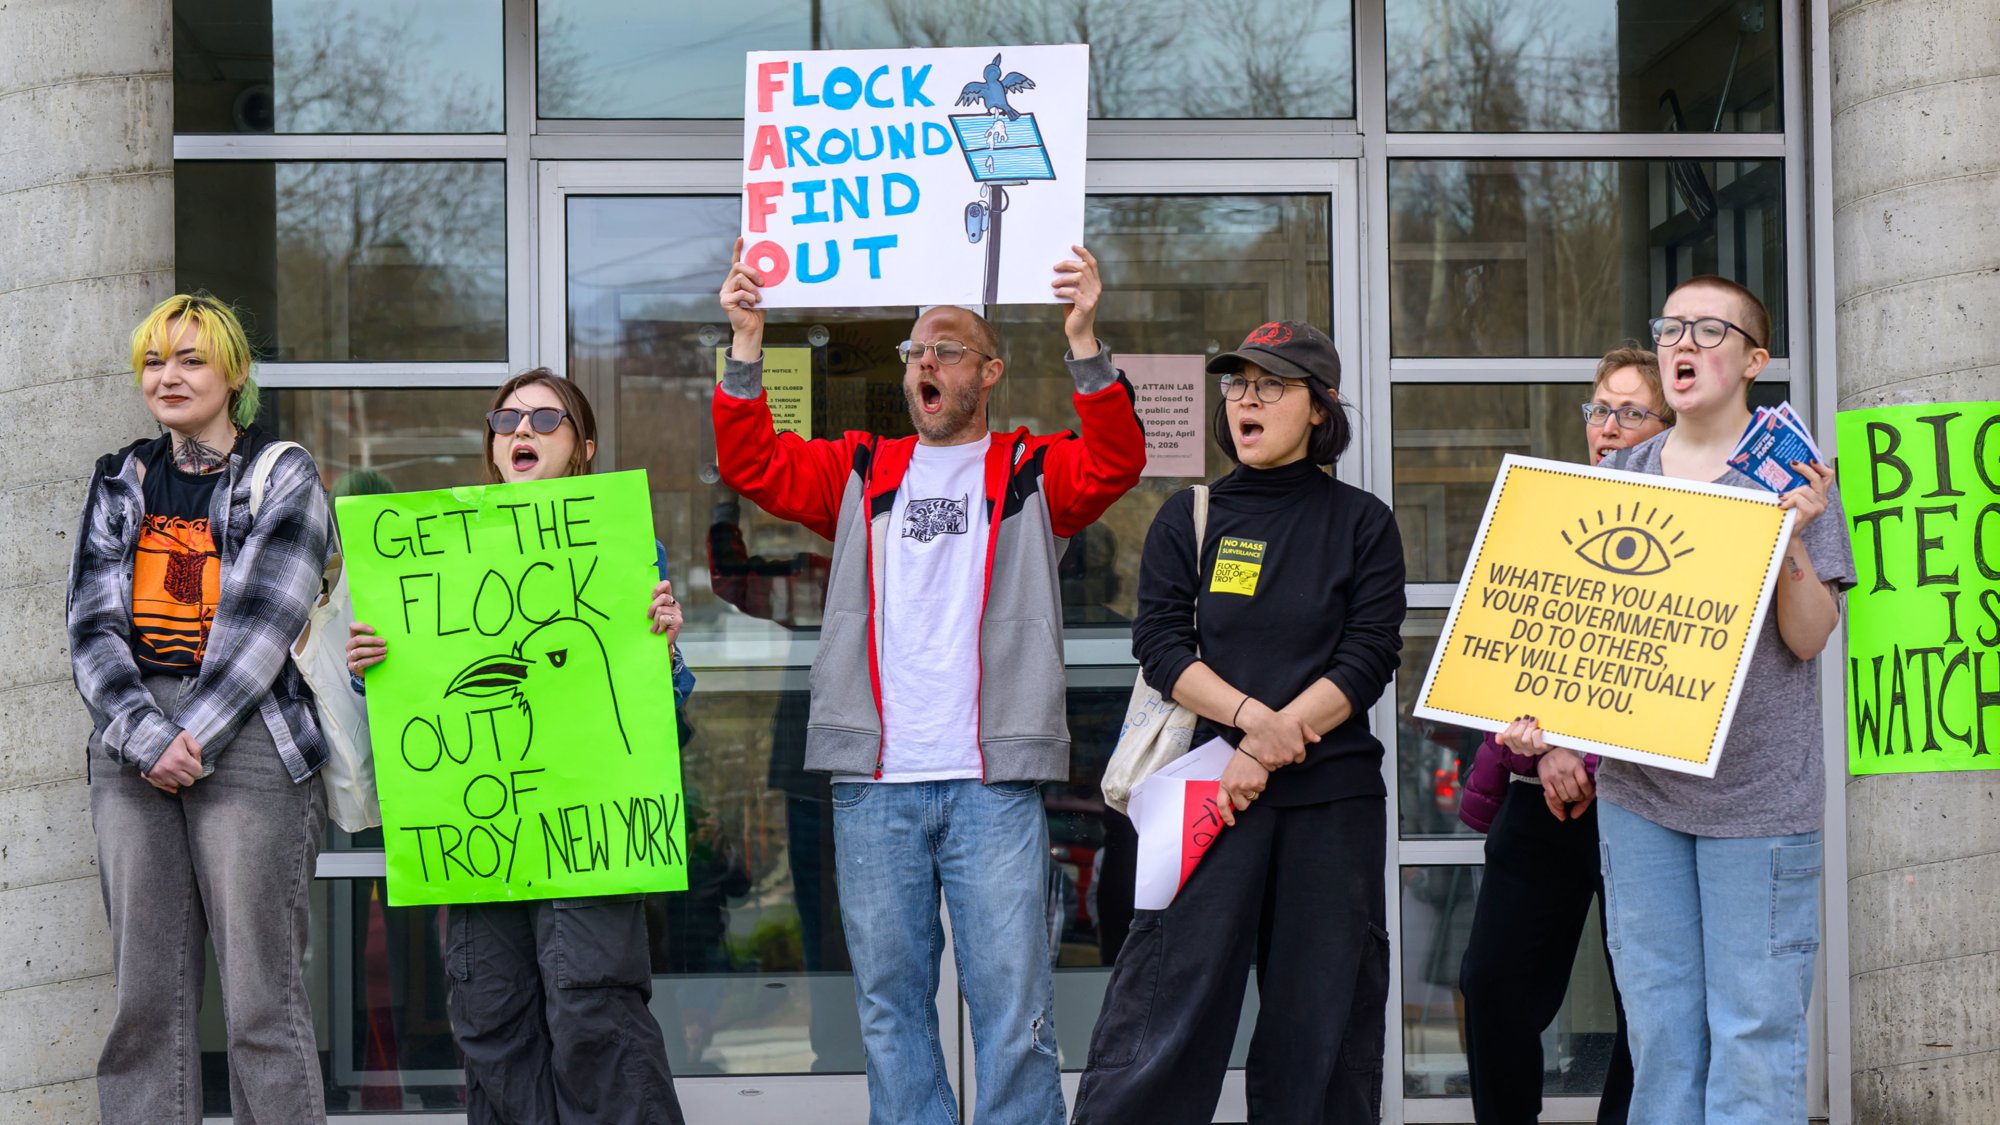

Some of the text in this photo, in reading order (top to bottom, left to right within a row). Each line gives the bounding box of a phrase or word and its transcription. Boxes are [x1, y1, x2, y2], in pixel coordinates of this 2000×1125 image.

[757, 61, 935, 113] FLOCK
[748, 120, 954, 171] AROUND
[746, 172, 921, 233] FIND
[744, 233, 898, 288] OUT
[1145, 407, 1171, 415] public
[1146, 419, 1175, 427] reopen
[1176, 430, 1195, 438] April
[373, 495, 598, 559] GET THE
[1224, 539, 1263, 551] NO MASS
[399, 556, 610, 637] FLOCK
[1481, 587, 1729, 651] YOUR GOVERNMENT TO
[1489, 563, 1739, 625] WHATEVER YOU ALLOW
[1462, 635, 1716, 702] THEY WILL EVENTUALLY
[1510, 619, 1669, 671] DO TO OTHERS,
[1514, 671, 1634, 715] DO TO YOU.
[463, 768, 546, 820] OF
[538, 803, 611, 880] NEW
[612, 793, 684, 868] YORK
